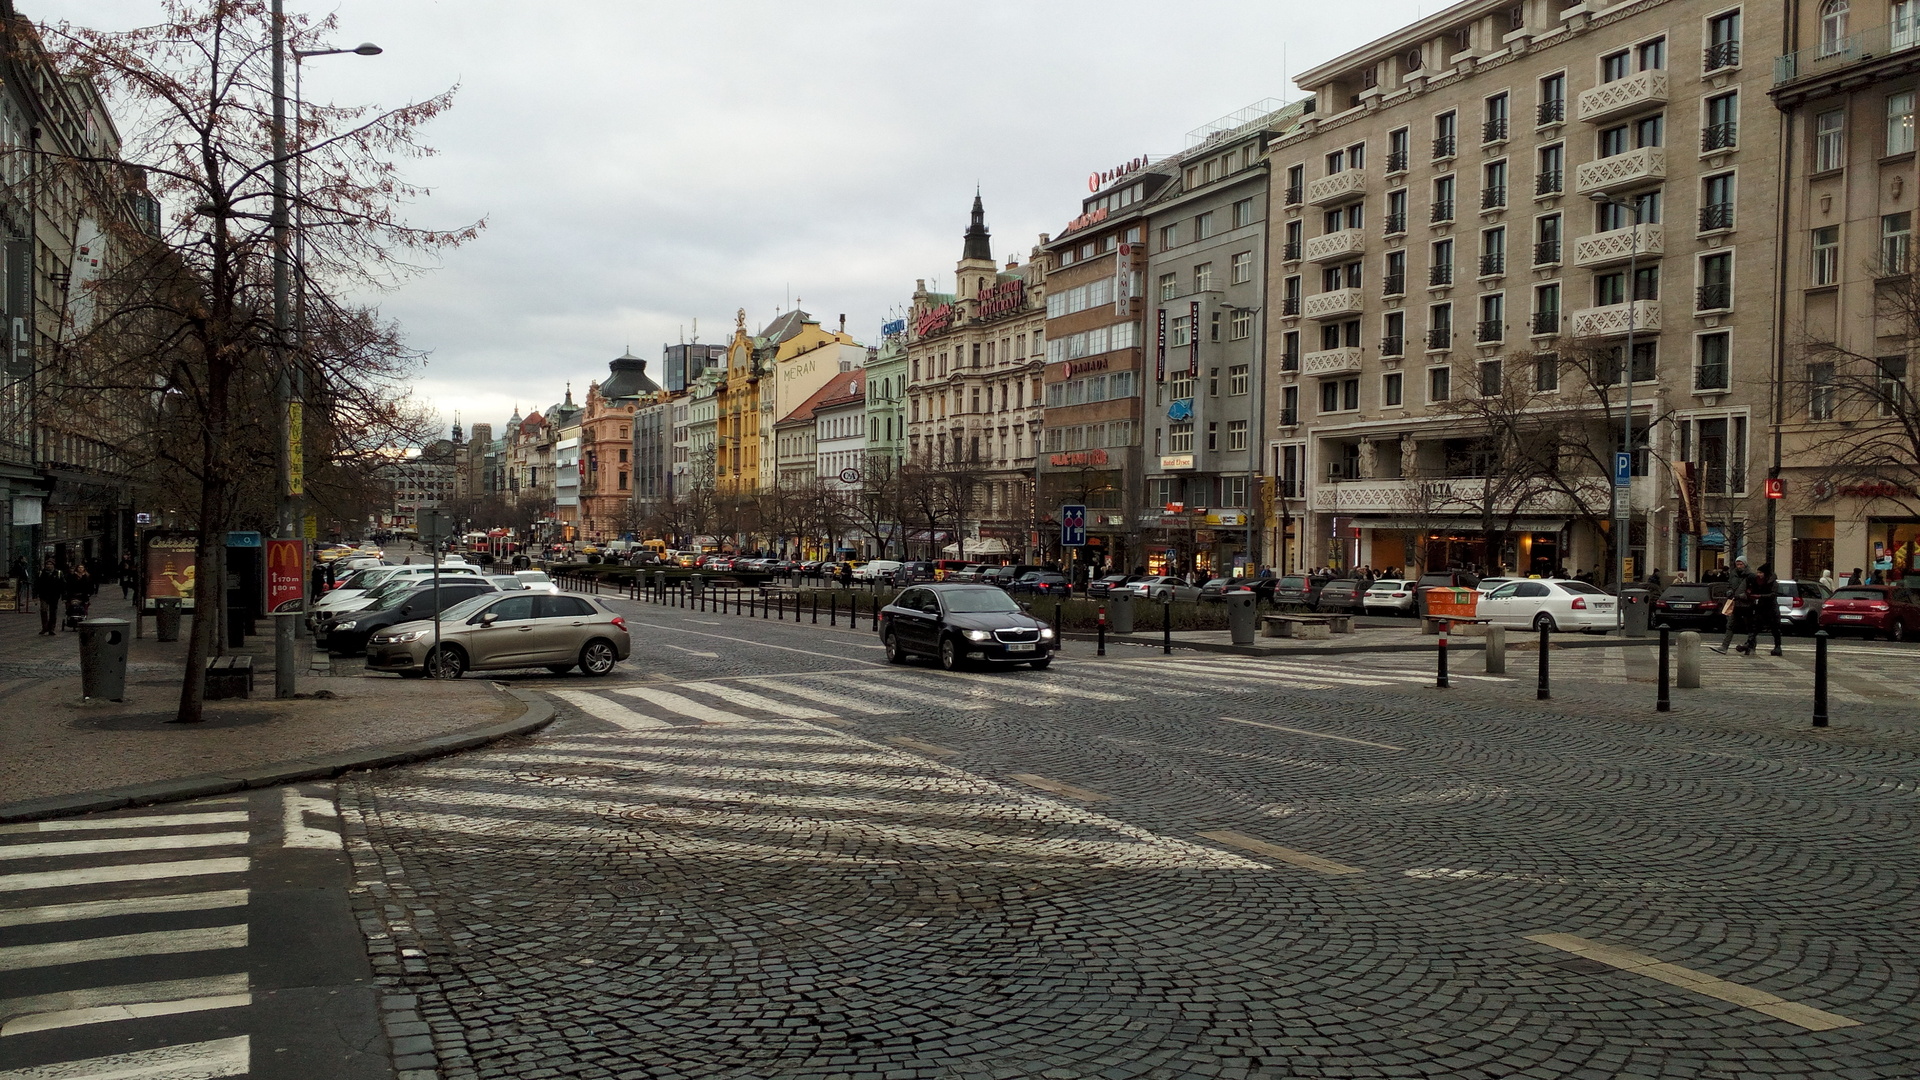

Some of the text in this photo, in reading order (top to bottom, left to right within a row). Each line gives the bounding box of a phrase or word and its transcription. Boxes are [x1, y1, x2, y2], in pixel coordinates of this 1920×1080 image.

[1363, 0, 1587, 89] HOTE
[1101, 154, 1149, 183] RAMADA
[1158, 311, 1166, 347] Elysee
[1191, 304, 1199, 341] Elysee
[784, 360, 816, 382] MERAN
[1072, 358, 1108, 375] RAMADA
[843, 472, 857, 480] C&A
[1619, 456, 1628, 476] P
